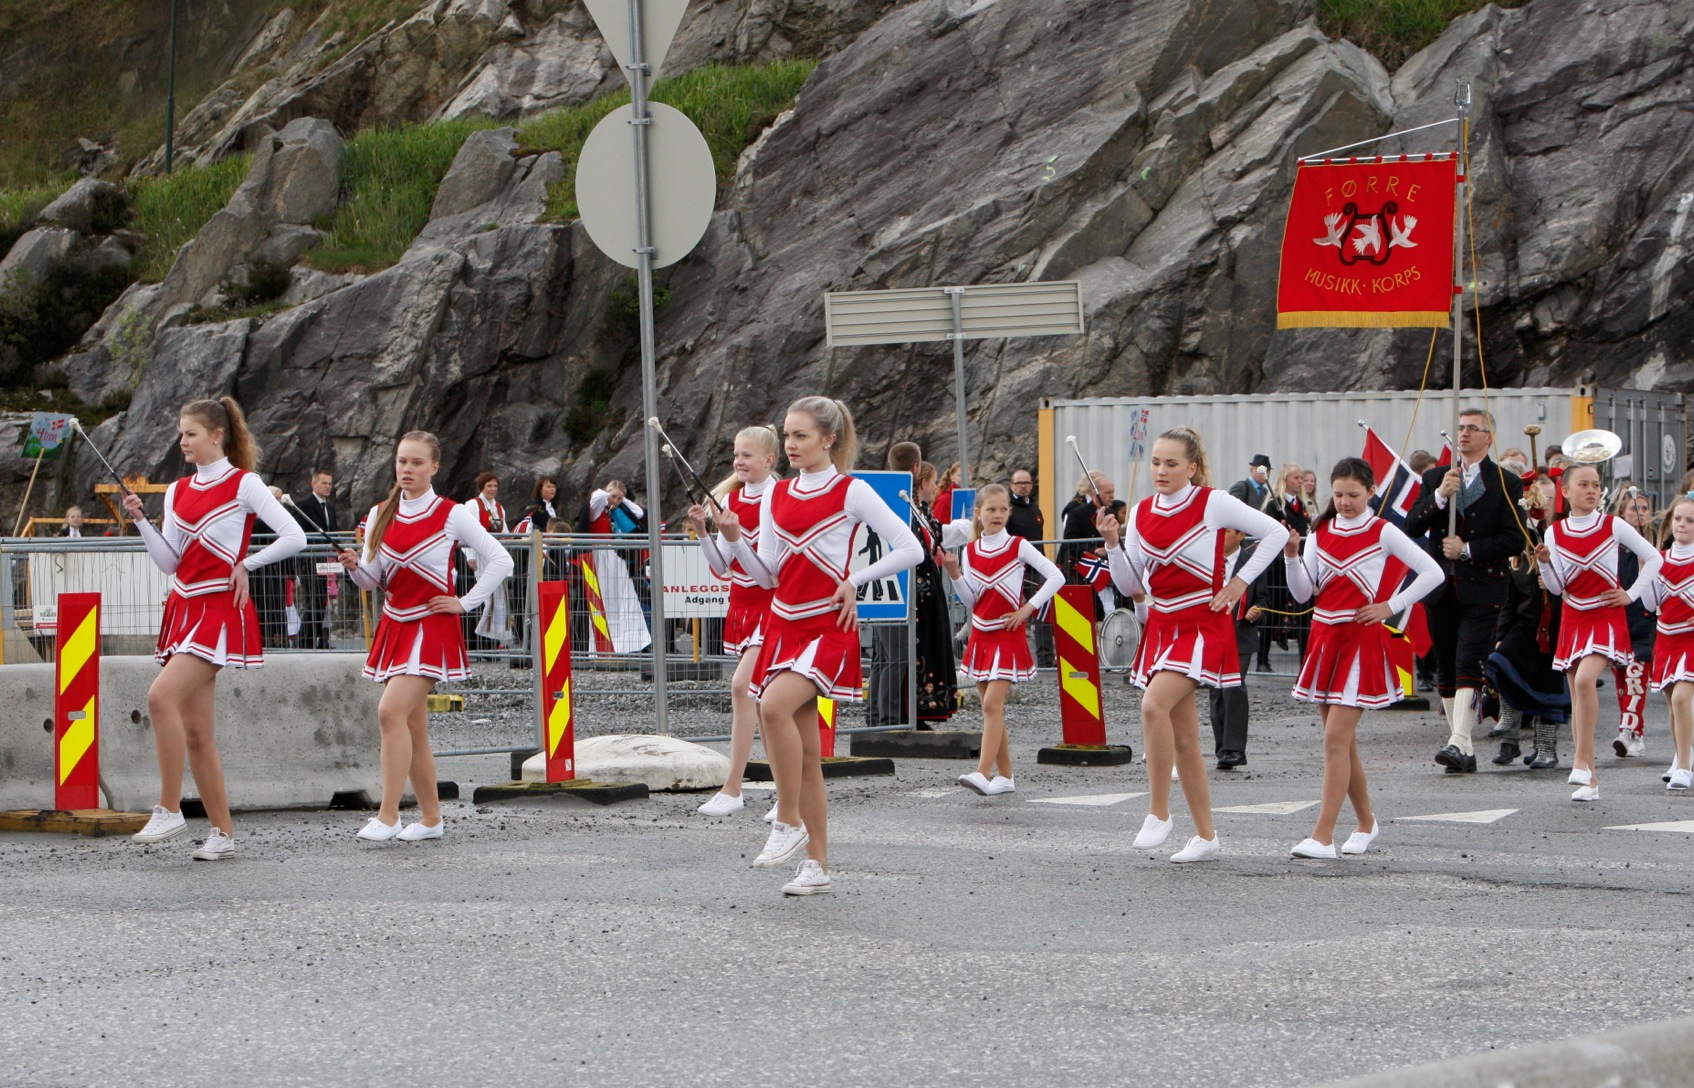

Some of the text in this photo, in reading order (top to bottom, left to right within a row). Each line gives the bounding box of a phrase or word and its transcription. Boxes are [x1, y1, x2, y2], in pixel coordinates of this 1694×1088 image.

[1325, 176, 1421, 206] FØRRE
[1304, 266, 1421, 295] MUSIKK KORPS
[685, 596, 724, 605] Adgang
